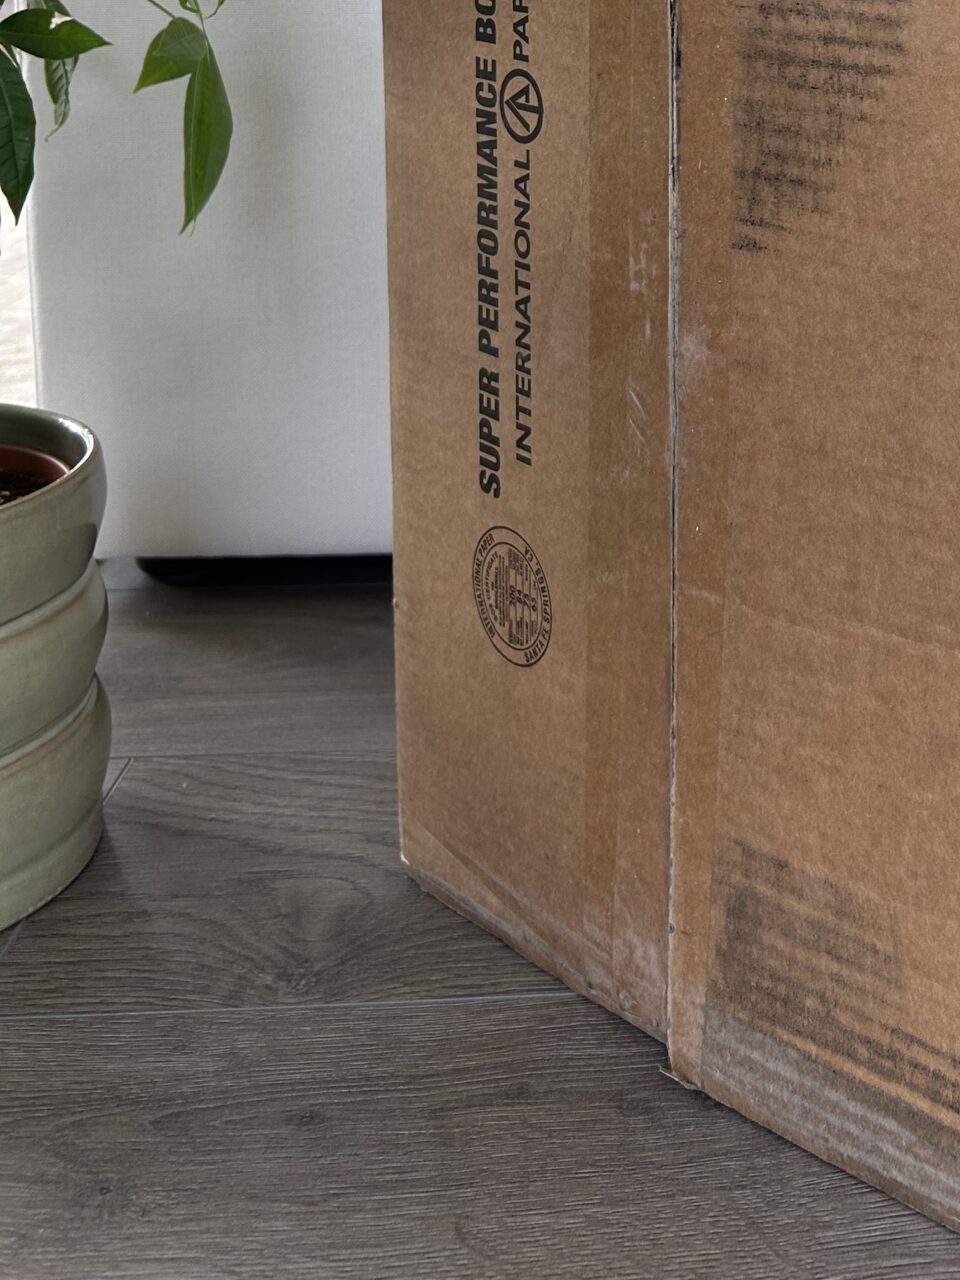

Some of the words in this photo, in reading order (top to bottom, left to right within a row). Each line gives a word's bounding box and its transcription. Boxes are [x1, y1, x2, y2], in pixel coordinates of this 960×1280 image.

[475, 56, 499, 358] PERFORMANCE
[513, 149, 532, 466] INTERNATIONAL
[479, 368, 500, 498] SUPER
[478, 533, 495, 558] PAPER
[524, 546, 534, 563] CA
[473, 556, 496, 639] INTERNATIONAL
[524, 639, 544, 663] SANTA
[541, 625, 549, 641] FE
